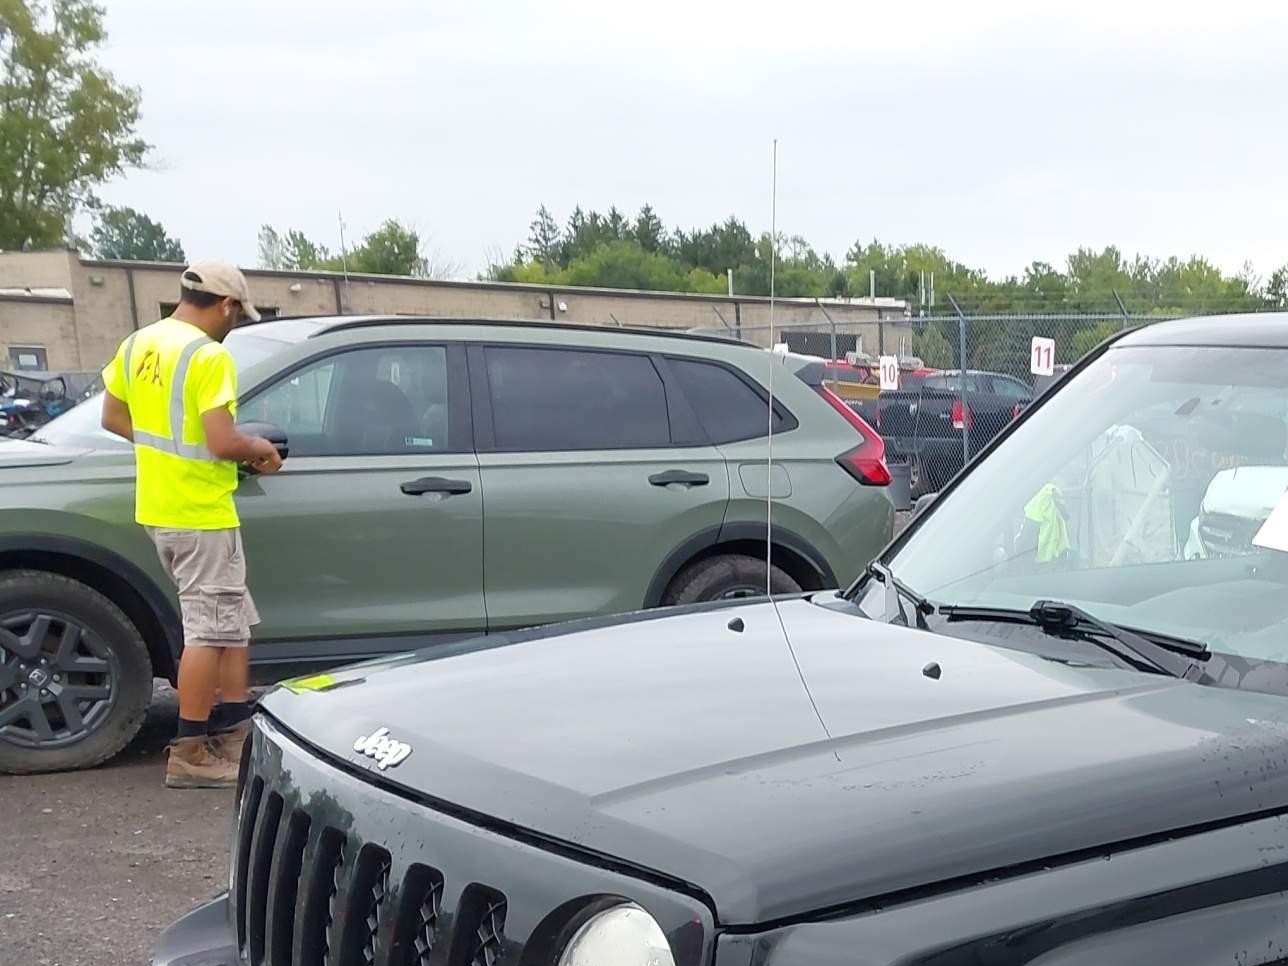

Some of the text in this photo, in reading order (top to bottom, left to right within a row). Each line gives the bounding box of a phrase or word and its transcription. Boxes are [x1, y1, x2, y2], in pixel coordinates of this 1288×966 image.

[1034, 345, 1051, 369] 11
[881, 363, 896, 384] 10
[353, 727, 413, 771] Jeep
